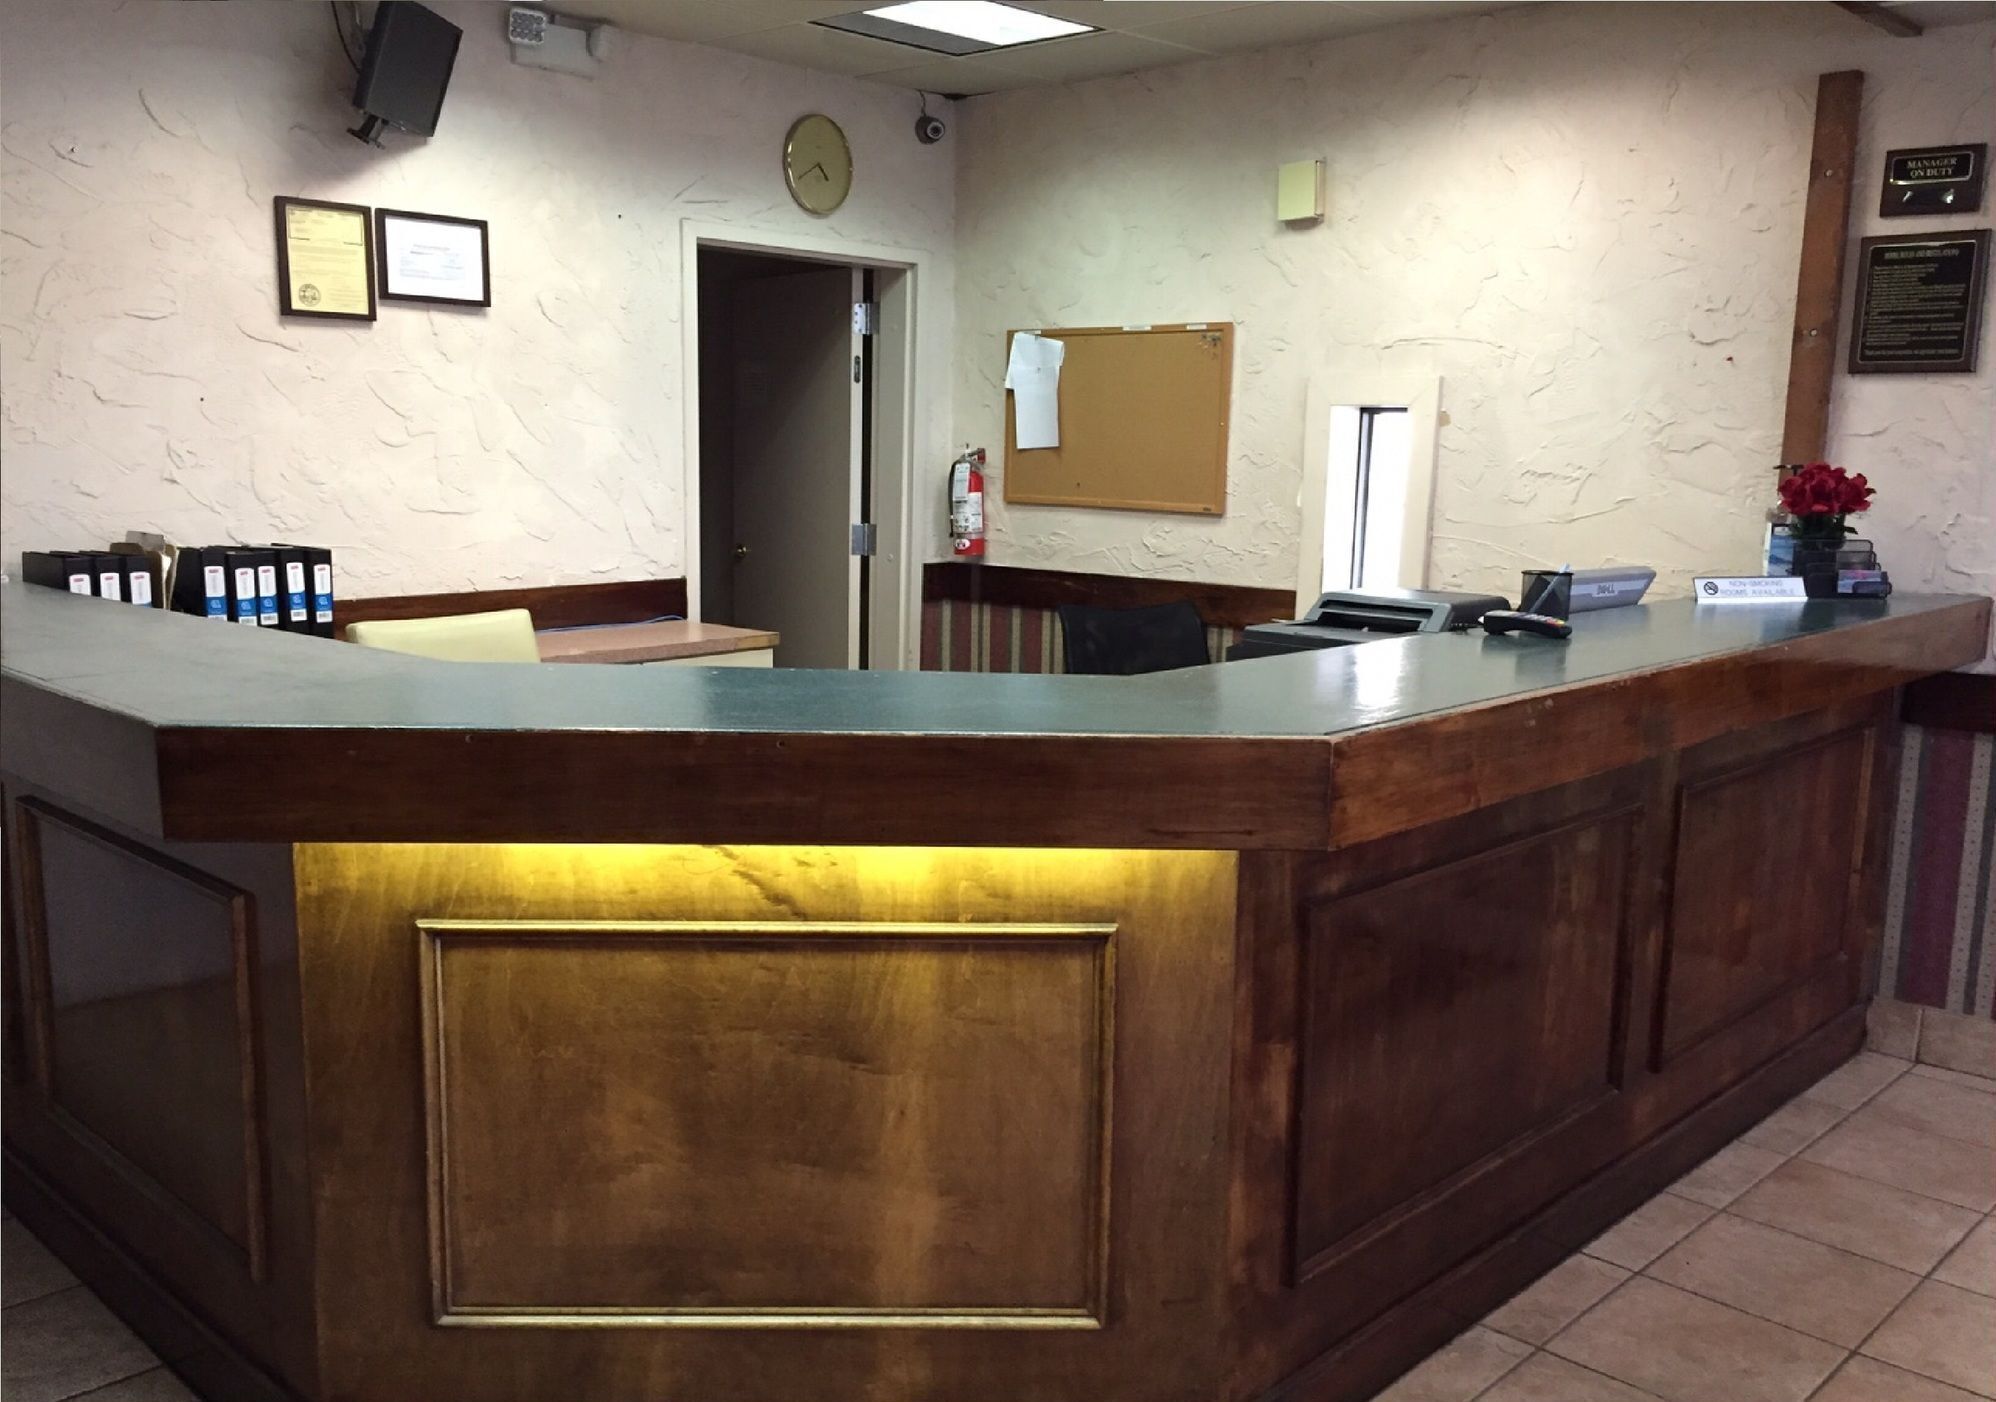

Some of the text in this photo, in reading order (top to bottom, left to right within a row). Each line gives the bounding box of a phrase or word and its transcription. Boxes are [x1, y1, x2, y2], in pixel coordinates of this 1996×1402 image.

[1907, 157, 1957, 168] MANAGER
[1910, 167, 1952, 178] ON DUTY
